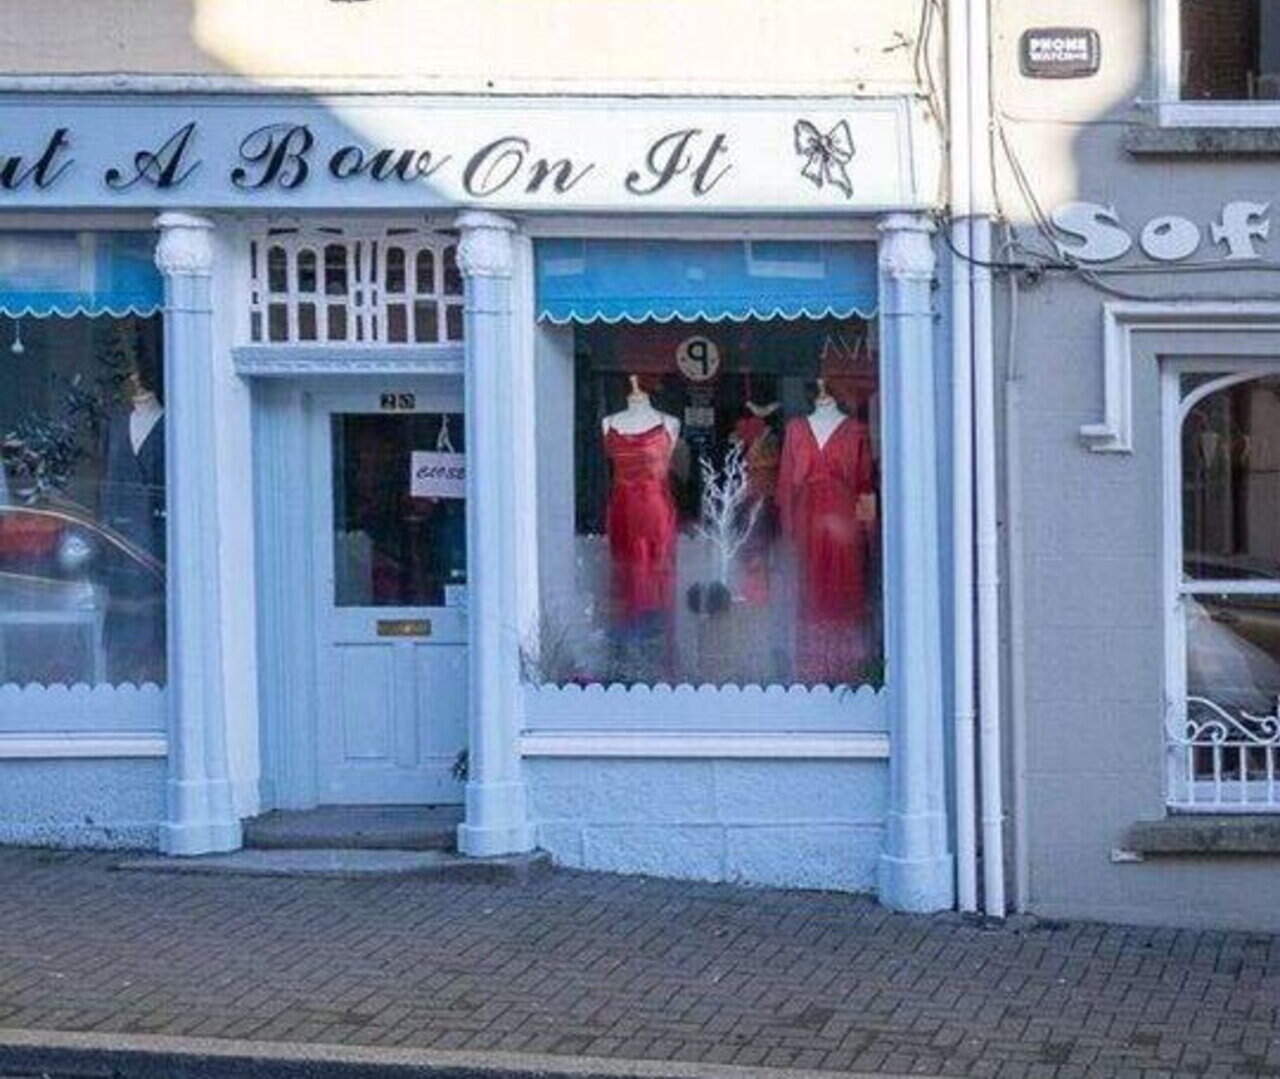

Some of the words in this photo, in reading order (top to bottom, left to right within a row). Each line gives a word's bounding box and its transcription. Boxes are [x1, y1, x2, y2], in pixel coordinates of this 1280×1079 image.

[1029, 37, 1087, 50] PHONE
[0, 128, 75, 190] ut
[105, 122, 203, 190] A
[231, 122, 452, 190] Bow
[462, 135, 595, 198] On
[625, 128, 733, 197] It
[416, 465, 465, 481] CLOSE
